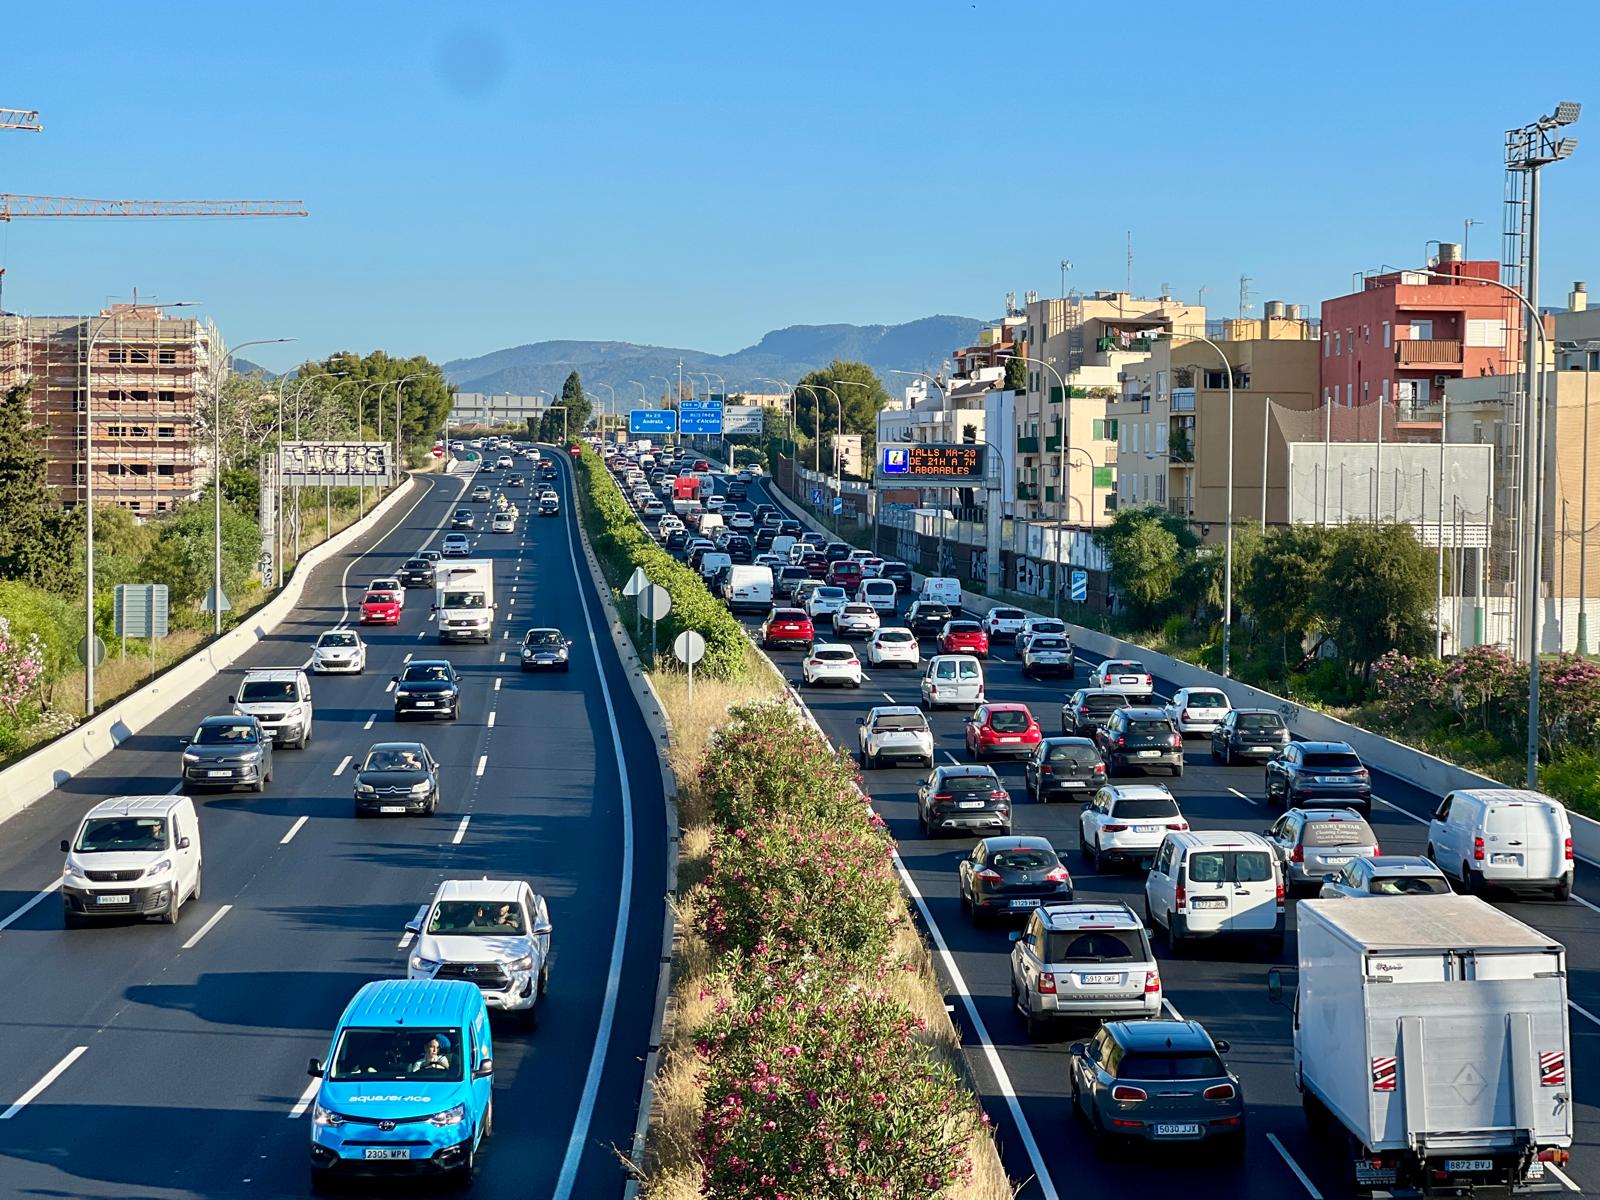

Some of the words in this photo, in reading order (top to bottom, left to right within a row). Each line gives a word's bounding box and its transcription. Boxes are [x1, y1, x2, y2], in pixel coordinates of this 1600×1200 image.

[910, 448, 940, 457] TALLS
[945, 449, 976, 458] MA-20
[909, 457, 922, 466] DE
[928, 457, 946, 466] 21H
[951, 458, 958, 466] A
[963, 458, 976, 466] 7H
[909, 466, 970, 475] LABORABLES
[1086, 975, 1102, 983] 5912
[348, 1095, 432, 1103] aquaservice
[1159, 1125, 1180, 1134] 5030
[1182, 1125, 1196, 1133] JJX
[367, 1149, 388, 1159] 2305
[390, 1149, 408, 1159] MPK
[1450, 1160, 1470, 1170] 8872
[1474, 1160, 1492, 1170] BVJ
